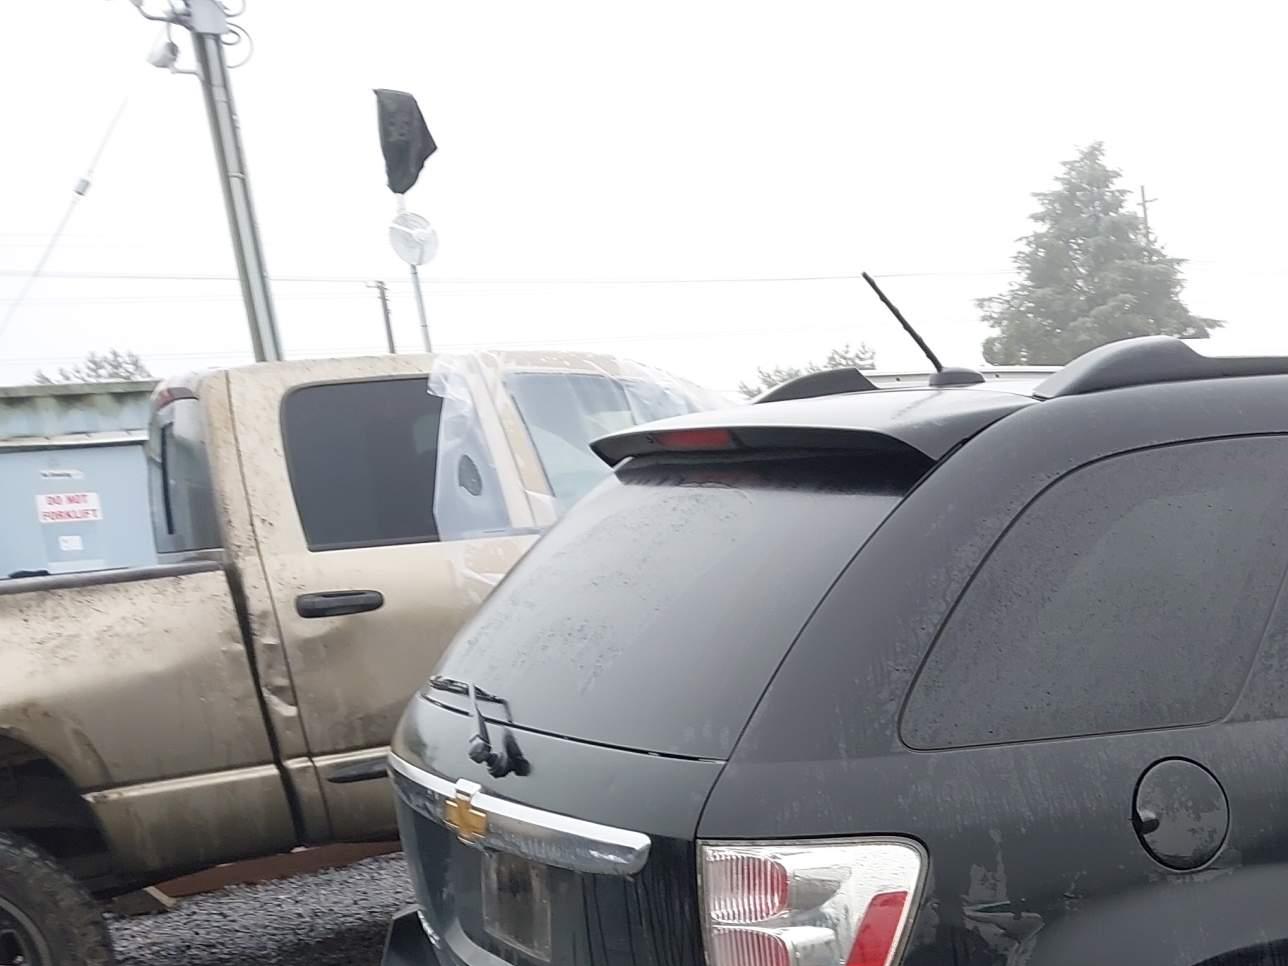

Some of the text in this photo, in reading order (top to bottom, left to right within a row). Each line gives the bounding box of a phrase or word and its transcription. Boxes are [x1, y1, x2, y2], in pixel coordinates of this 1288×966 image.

[47, 494, 88, 505] DO NOT
[42, 508, 98, 520] FORKLIFT
